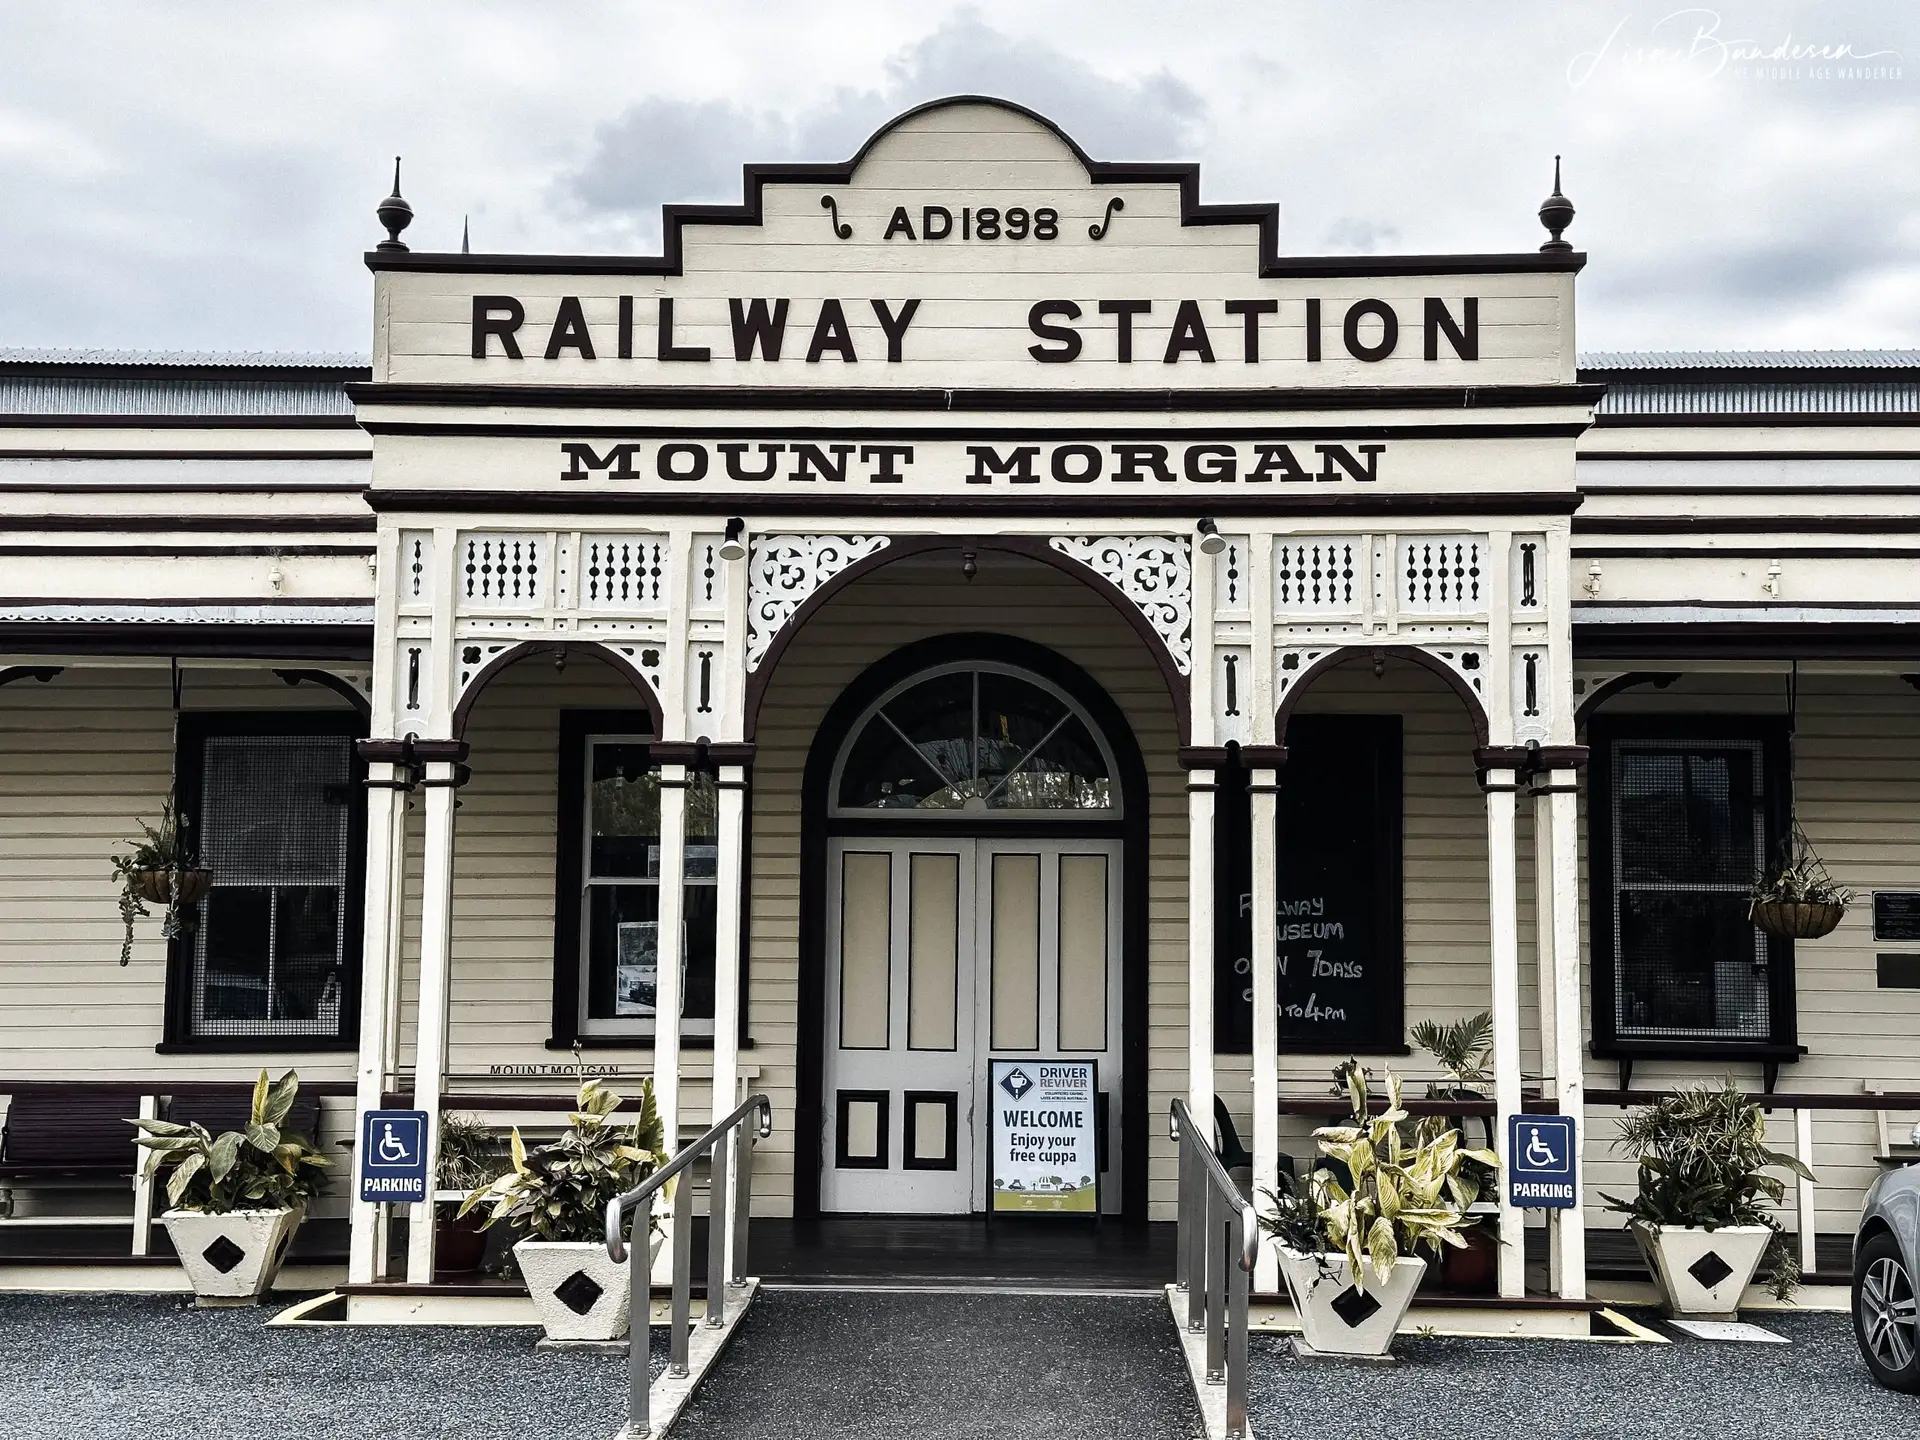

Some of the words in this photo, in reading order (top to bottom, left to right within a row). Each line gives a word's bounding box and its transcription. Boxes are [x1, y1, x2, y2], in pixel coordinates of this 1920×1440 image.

[471, 295, 922, 363] RAILWAY
[1027, 296, 1479, 364] STATION
[560, 442, 914, 484] MOUNT
[965, 444, 1386, 485] MORGAN
[1276, 922, 1345, 942] USEUM
[1040, 1067, 1088, 1079] DRIVER
[1040, 1078, 1088, 1088] REVIVER
[1003, 1110, 1084, 1128] WELCOME
[1010, 1132, 1045, 1149] Enjoy
[1047, 1135, 1077, 1149] your
[1009, 1148, 1036, 1162] free
[1038, 1151, 1077, 1166] cuppa
[364, 1178, 422, 1192] PARKING
[1513, 1182, 1573, 1198] PARKING
